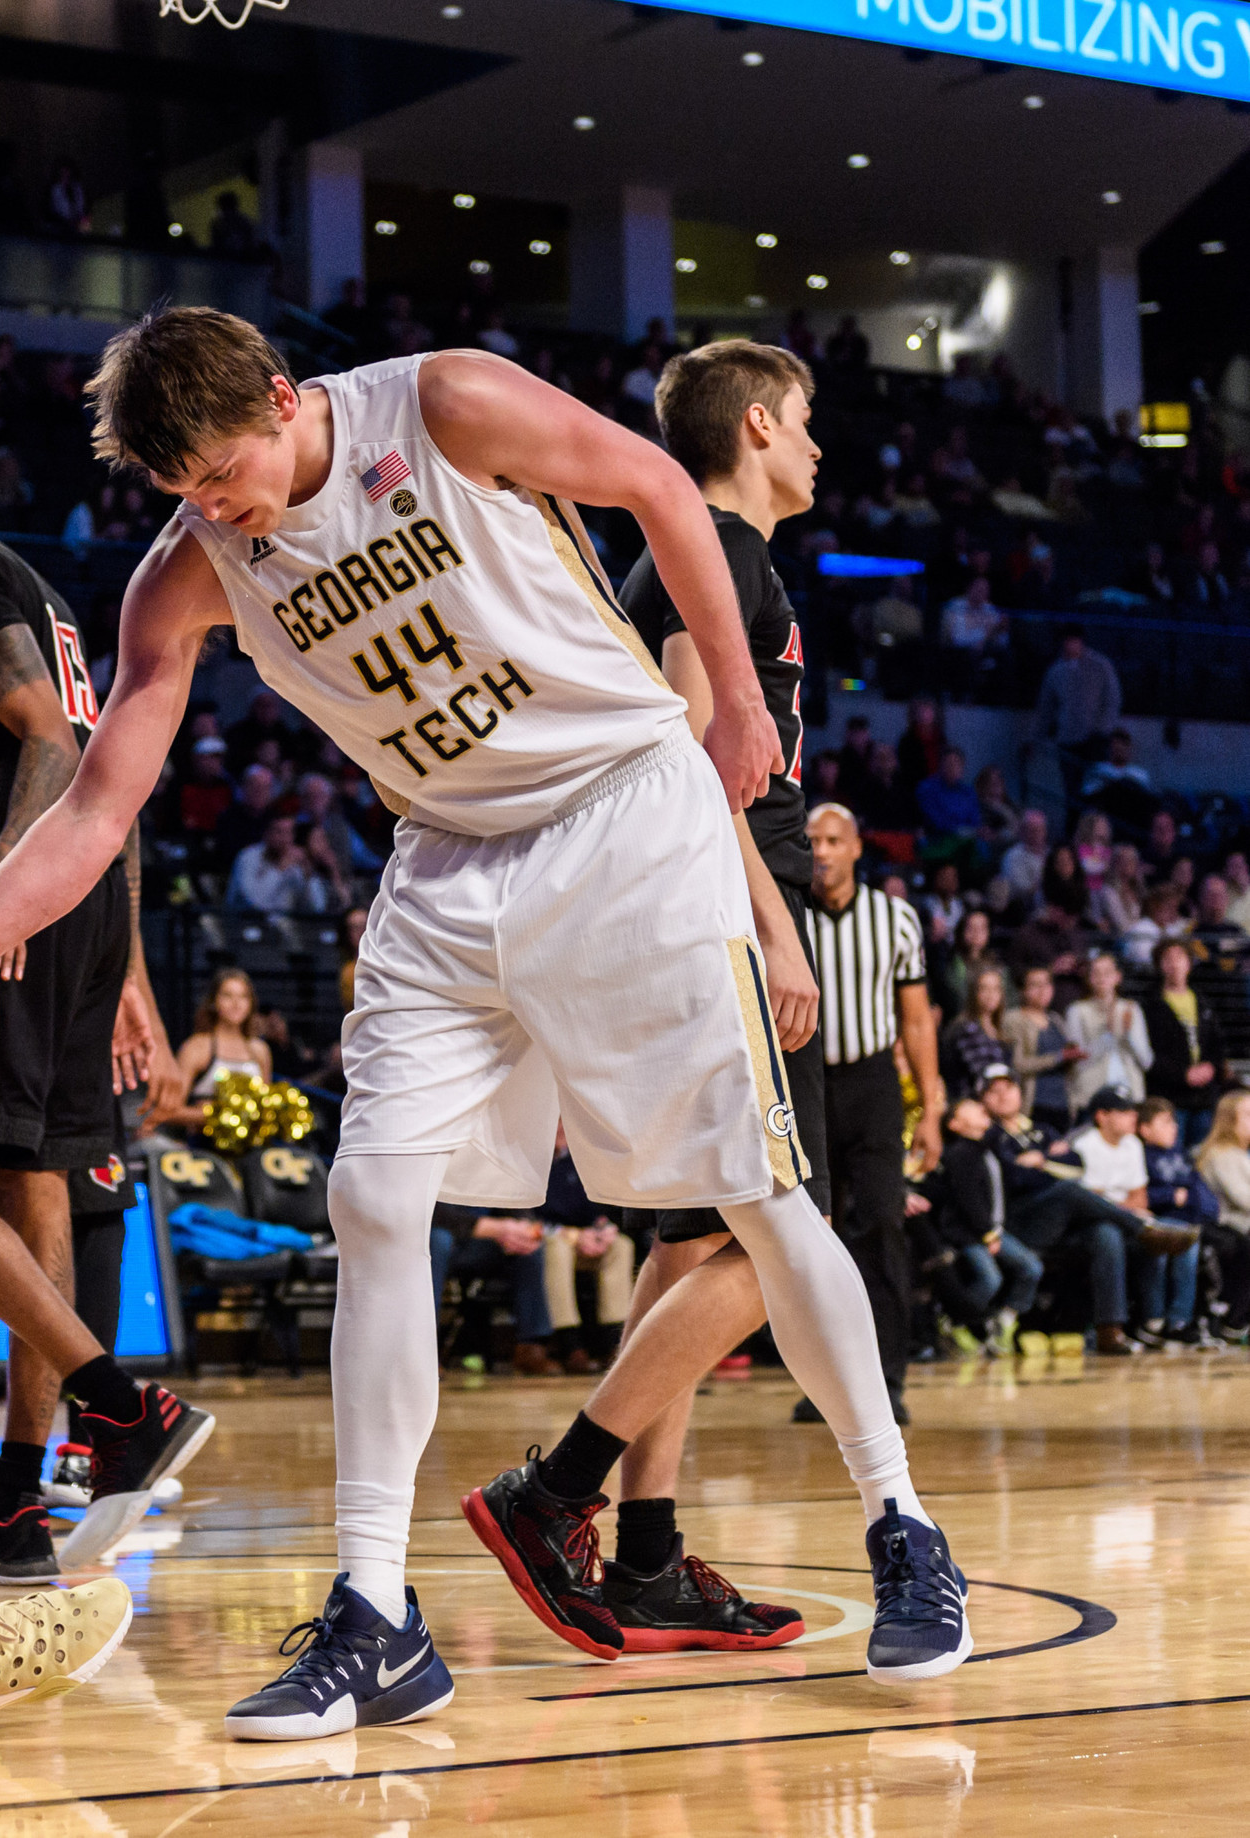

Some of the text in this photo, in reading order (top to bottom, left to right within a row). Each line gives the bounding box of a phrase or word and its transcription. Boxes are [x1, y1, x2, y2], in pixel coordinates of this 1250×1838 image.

[272, 516, 466, 654] GEORGIA
[350, 599, 468, 706] 44
[377, 658, 536, 778] TECH
